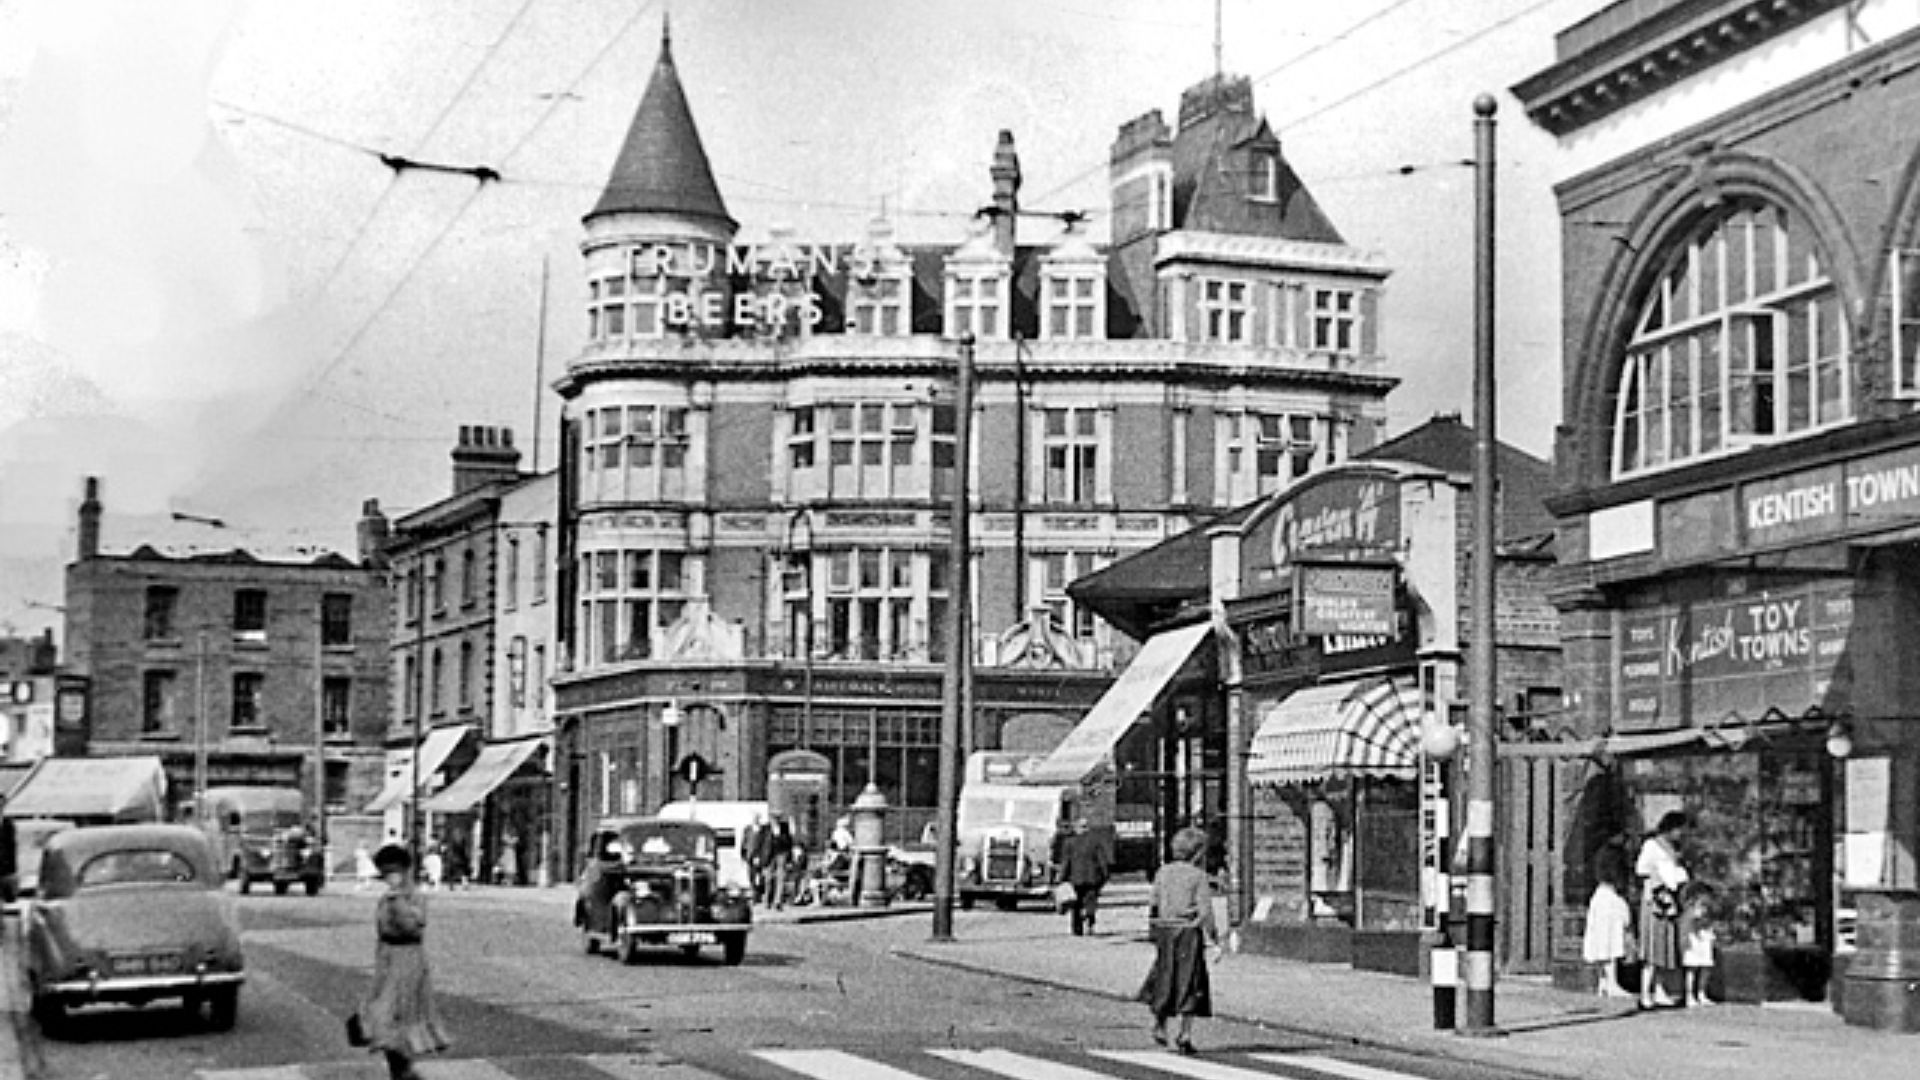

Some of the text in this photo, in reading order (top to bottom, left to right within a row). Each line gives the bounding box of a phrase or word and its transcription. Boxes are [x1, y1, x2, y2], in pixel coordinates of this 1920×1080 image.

[666, 293, 823, 325] BEERS
[1748, 464, 1919, 529] KENTISH TOWN
[1748, 599, 1801, 632] TOY
[1739, 627, 1811, 661] TOWNS
